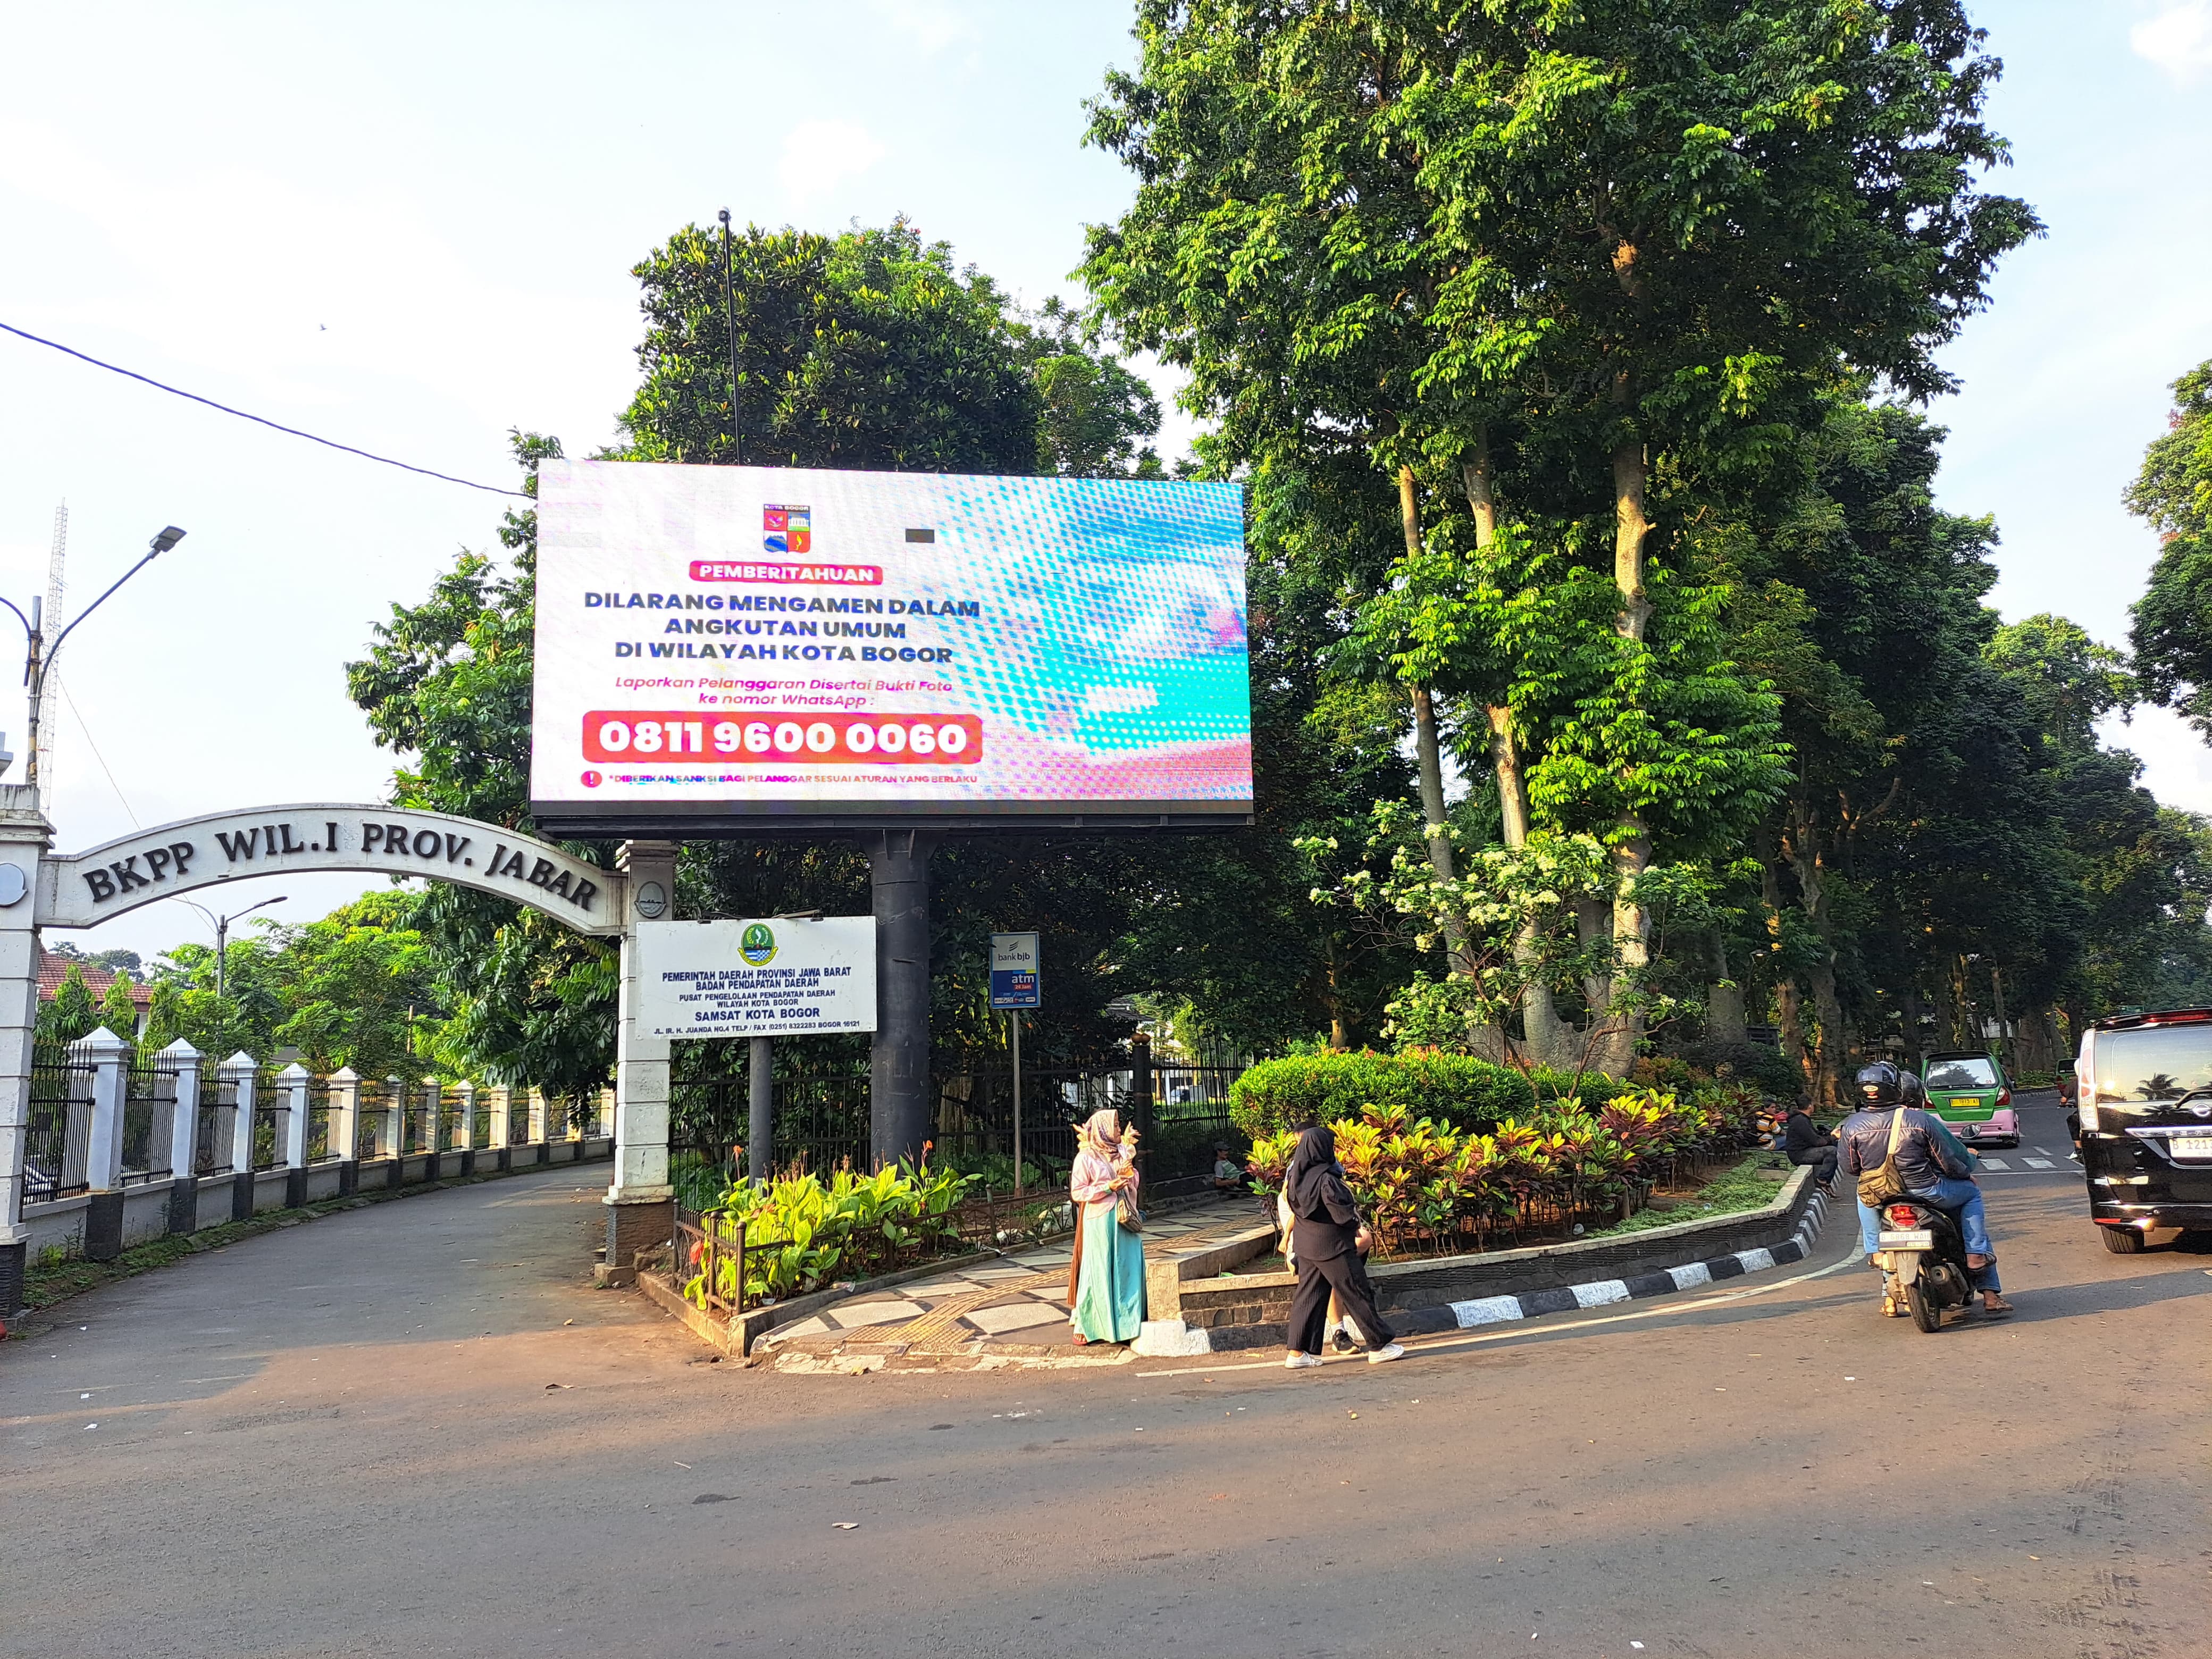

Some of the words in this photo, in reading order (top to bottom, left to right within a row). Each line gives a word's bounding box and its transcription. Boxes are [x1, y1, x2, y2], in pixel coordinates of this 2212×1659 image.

[699, 564, 874, 582] PEMBERITAHUAN
[584, 592, 724, 610] DILARANG
[729, 595, 883, 614] MENGAMEN
[889, 599, 979, 616] DALAM
[664, 618, 817, 636] ANGKUTAN
[824, 621, 906, 638] UMUM
[615, 642, 641, 658] DI
[649, 642, 776, 660] WILAYAH
[782, 644, 856, 661] KOTA
[862, 647, 952, 663] BOGOR
[616, 676, 694, 691] Laporkan
[699, 677, 805, 692] Pelanggaran
[810, 678, 871, 691] Disertai
[876, 680, 915, 691] Bukti
[919, 680, 952, 692] Foto
[699, 693, 718, 705] ke
[723, 696, 777, 706] nomor
[782, 694, 866, 708] WhatsApp
[599, 721, 703, 752] 0811
[714, 722, 836, 753] 9600
[845, 723, 966, 753] 0060
[82, 842, 195, 903] BKPP
[362, 823, 472, 866] PROV.
[484, 843, 597, 911] JABAR
[1017, 952, 1030, 961] bjb
[663, 971, 715, 982] PEMERINTAH
[719, 970, 753, 979] DAERAH
[757, 968, 795, 978] PROVINSI
[799, 968, 820, 977] JAWA
[824, 967, 851, 976] BARAT
[1012, 975, 1034, 983] atm
[696, 981, 724, 991] BADAN
[728, 979, 781, 990] PENDAPATAN
[785, 978, 819, 987] DAERAH
[705, 992, 757, 1001] PENGELOLAAN
[695, 1011, 741, 1021] SAMSAT
[745, 1009, 775, 1019] KOTA
[781, 1008, 820, 1018] BOGOR
[2173, 1139, 2179, 1150] B
